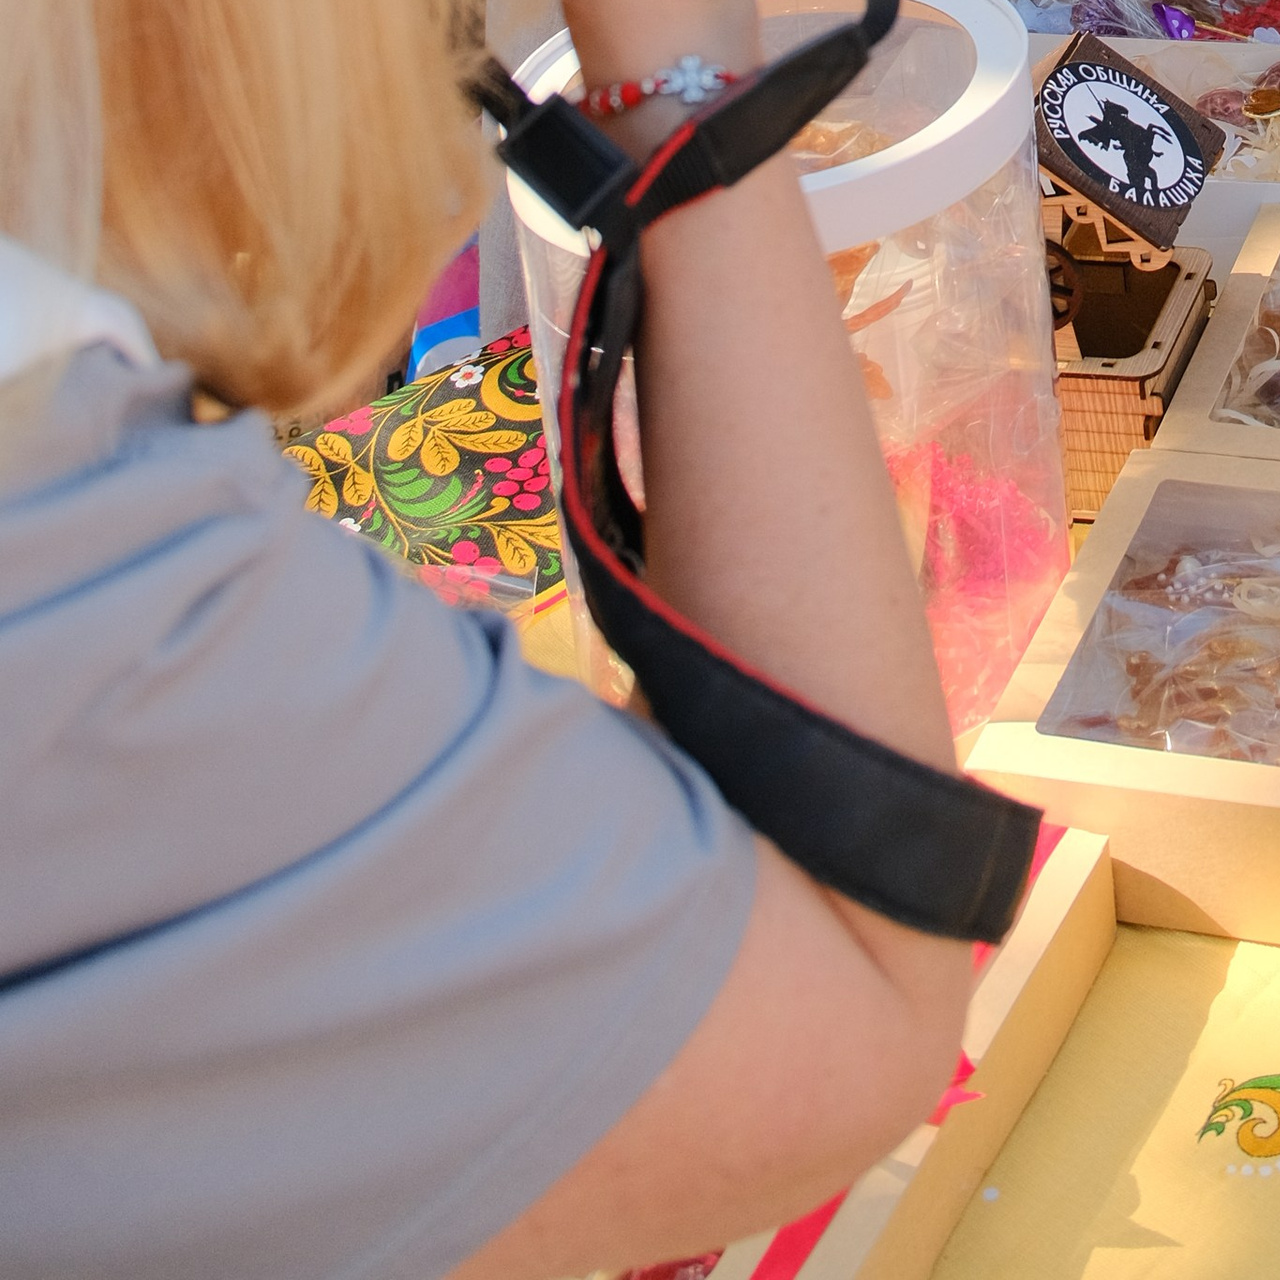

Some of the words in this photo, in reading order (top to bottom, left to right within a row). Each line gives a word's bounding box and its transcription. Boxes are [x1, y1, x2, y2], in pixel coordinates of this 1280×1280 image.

[1043, 67, 1078, 140] РУССКАЯ
[1078, 63, 1170, 115] ОБЩИНА
[1108, 155, 1204, 208] БАЛАШИХА
